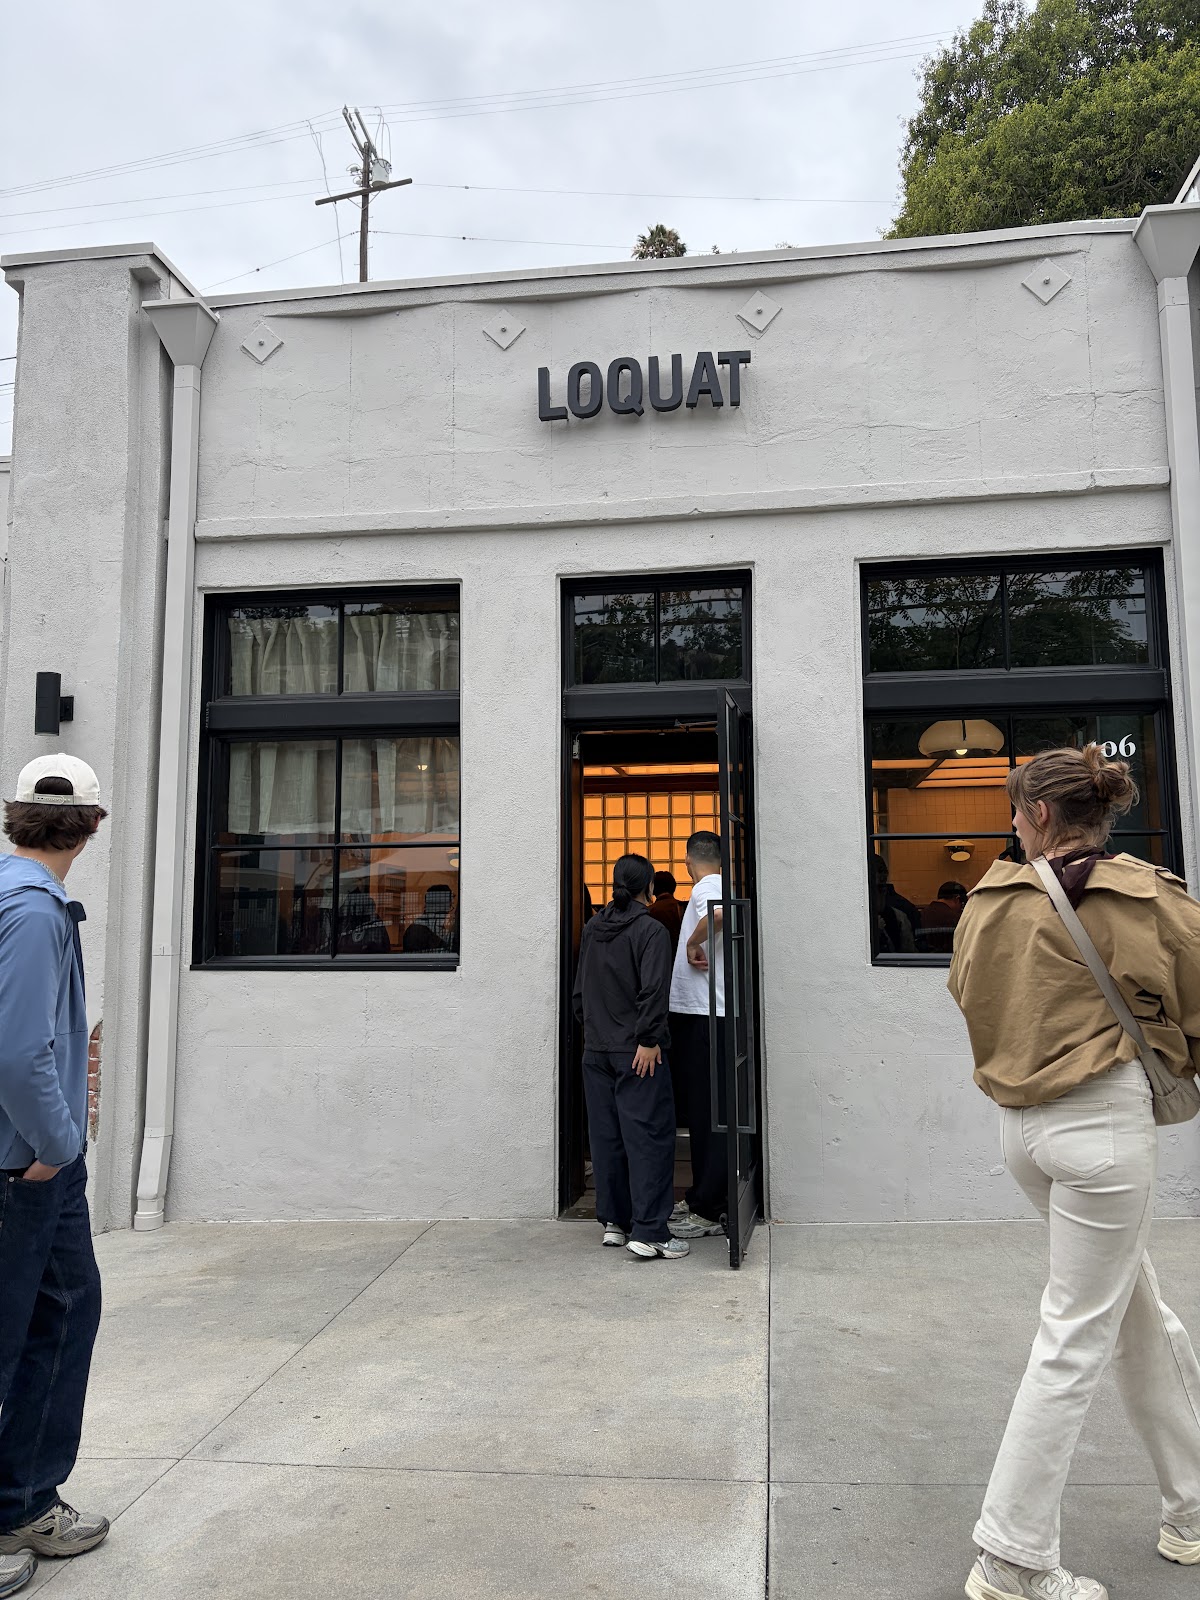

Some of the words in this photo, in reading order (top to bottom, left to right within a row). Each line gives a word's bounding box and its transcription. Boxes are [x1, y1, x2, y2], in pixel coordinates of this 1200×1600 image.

[538, 350, 751, 422] LOQUAT
[1091, 733, 1136, 758] 06
[1038, 1575, 1060, 1595] N
